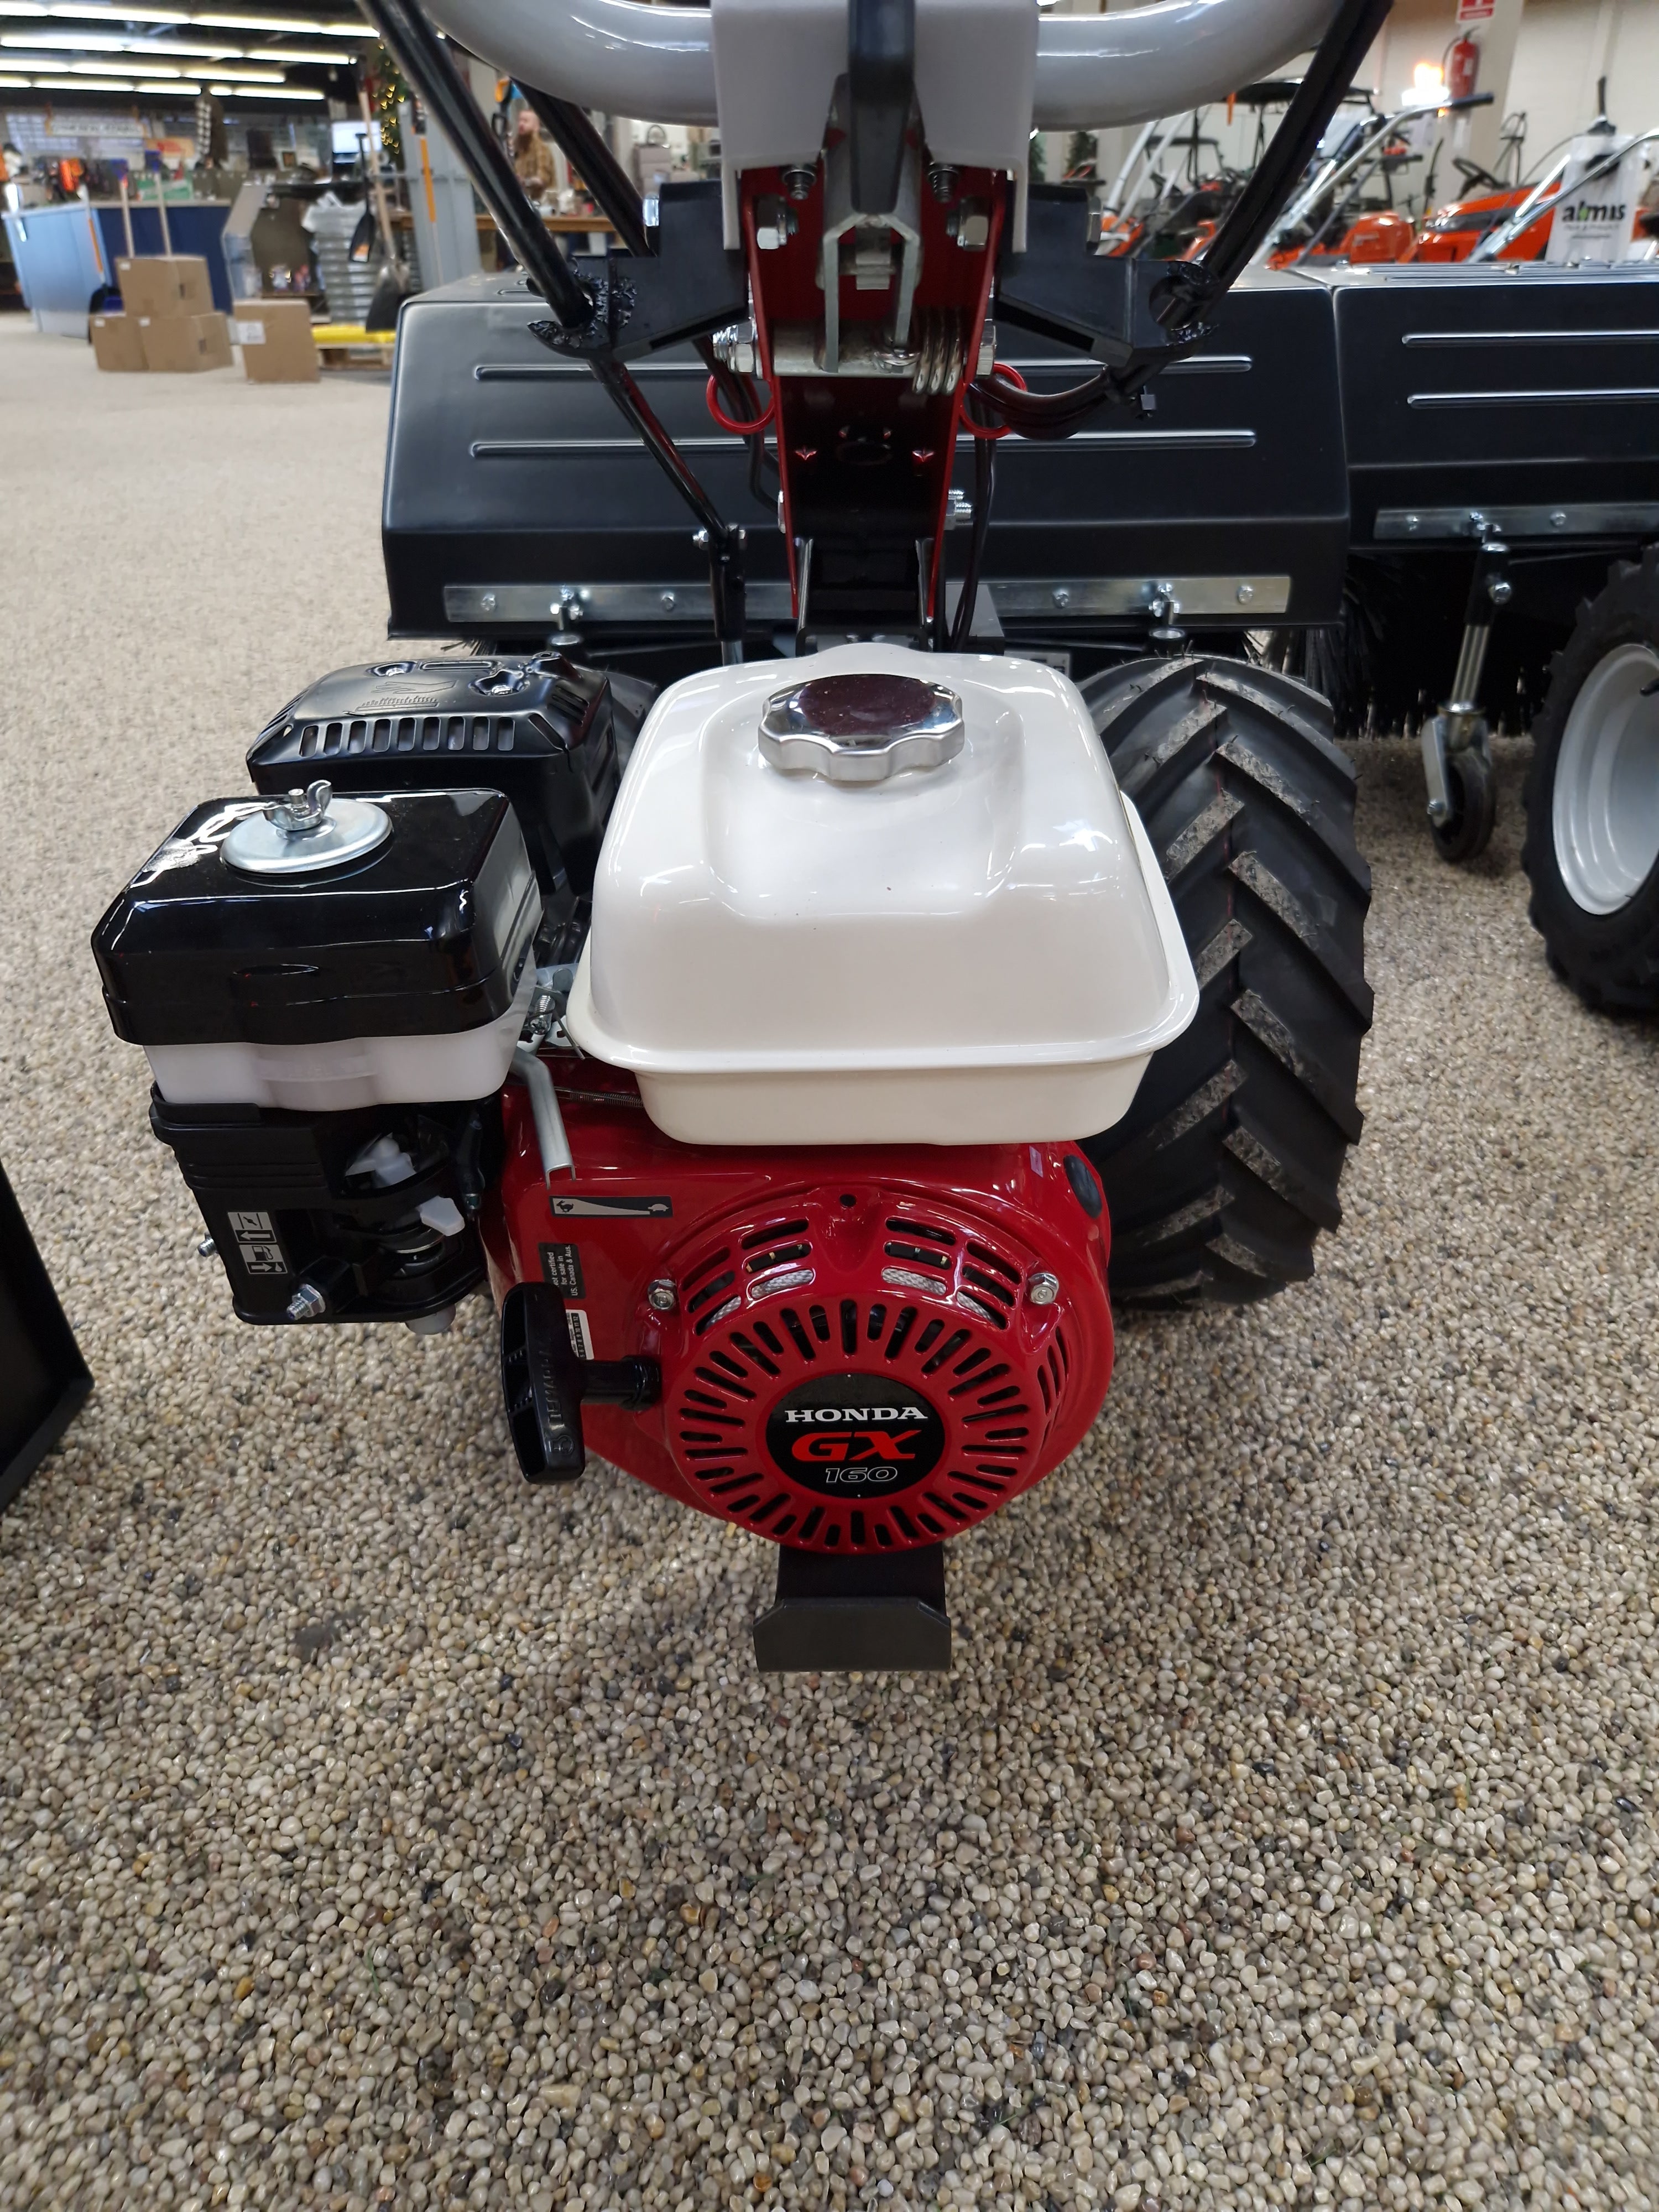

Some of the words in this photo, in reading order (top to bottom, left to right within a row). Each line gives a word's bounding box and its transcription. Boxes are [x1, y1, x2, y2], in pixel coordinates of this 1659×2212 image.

[547, 1252, 557, 1276] certified
[567, 1265, 576, 1285] Canada
[784, 1407, 928, 1422] HONDA
[792, 1430, 922, 1462] GX
[825, 1467, 898, 1483] 160
